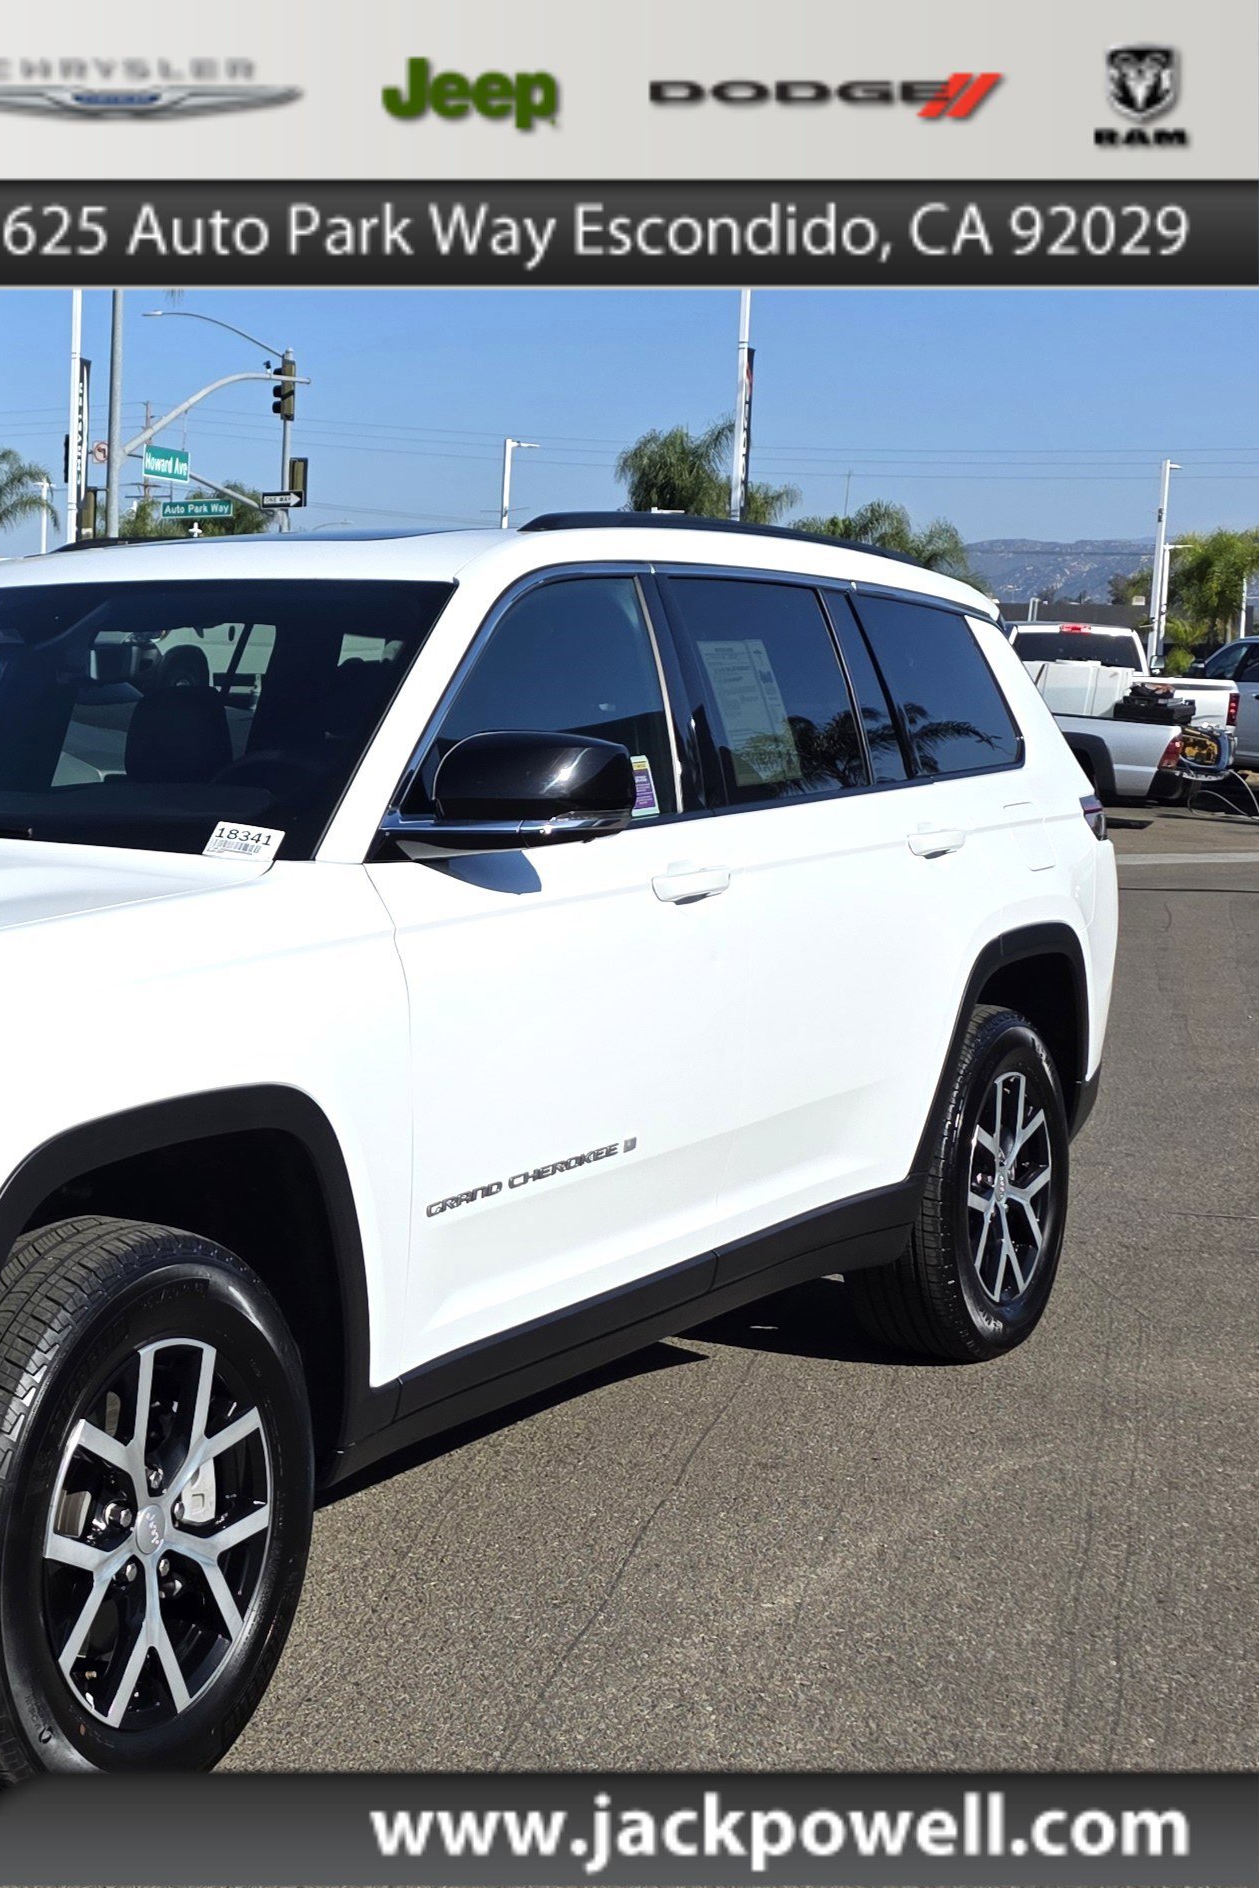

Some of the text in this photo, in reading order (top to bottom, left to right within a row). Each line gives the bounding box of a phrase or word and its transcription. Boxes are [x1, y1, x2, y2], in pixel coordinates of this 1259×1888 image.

[144, 453, 189, 476] Howard Ave
[163, 502, 230, 515] Auto Park Way
[214, 827, 272, 847] 18341
[426, 1181, 503, 1218] GRAND
[508, 1142, 620, 1189] CHEROKEE
